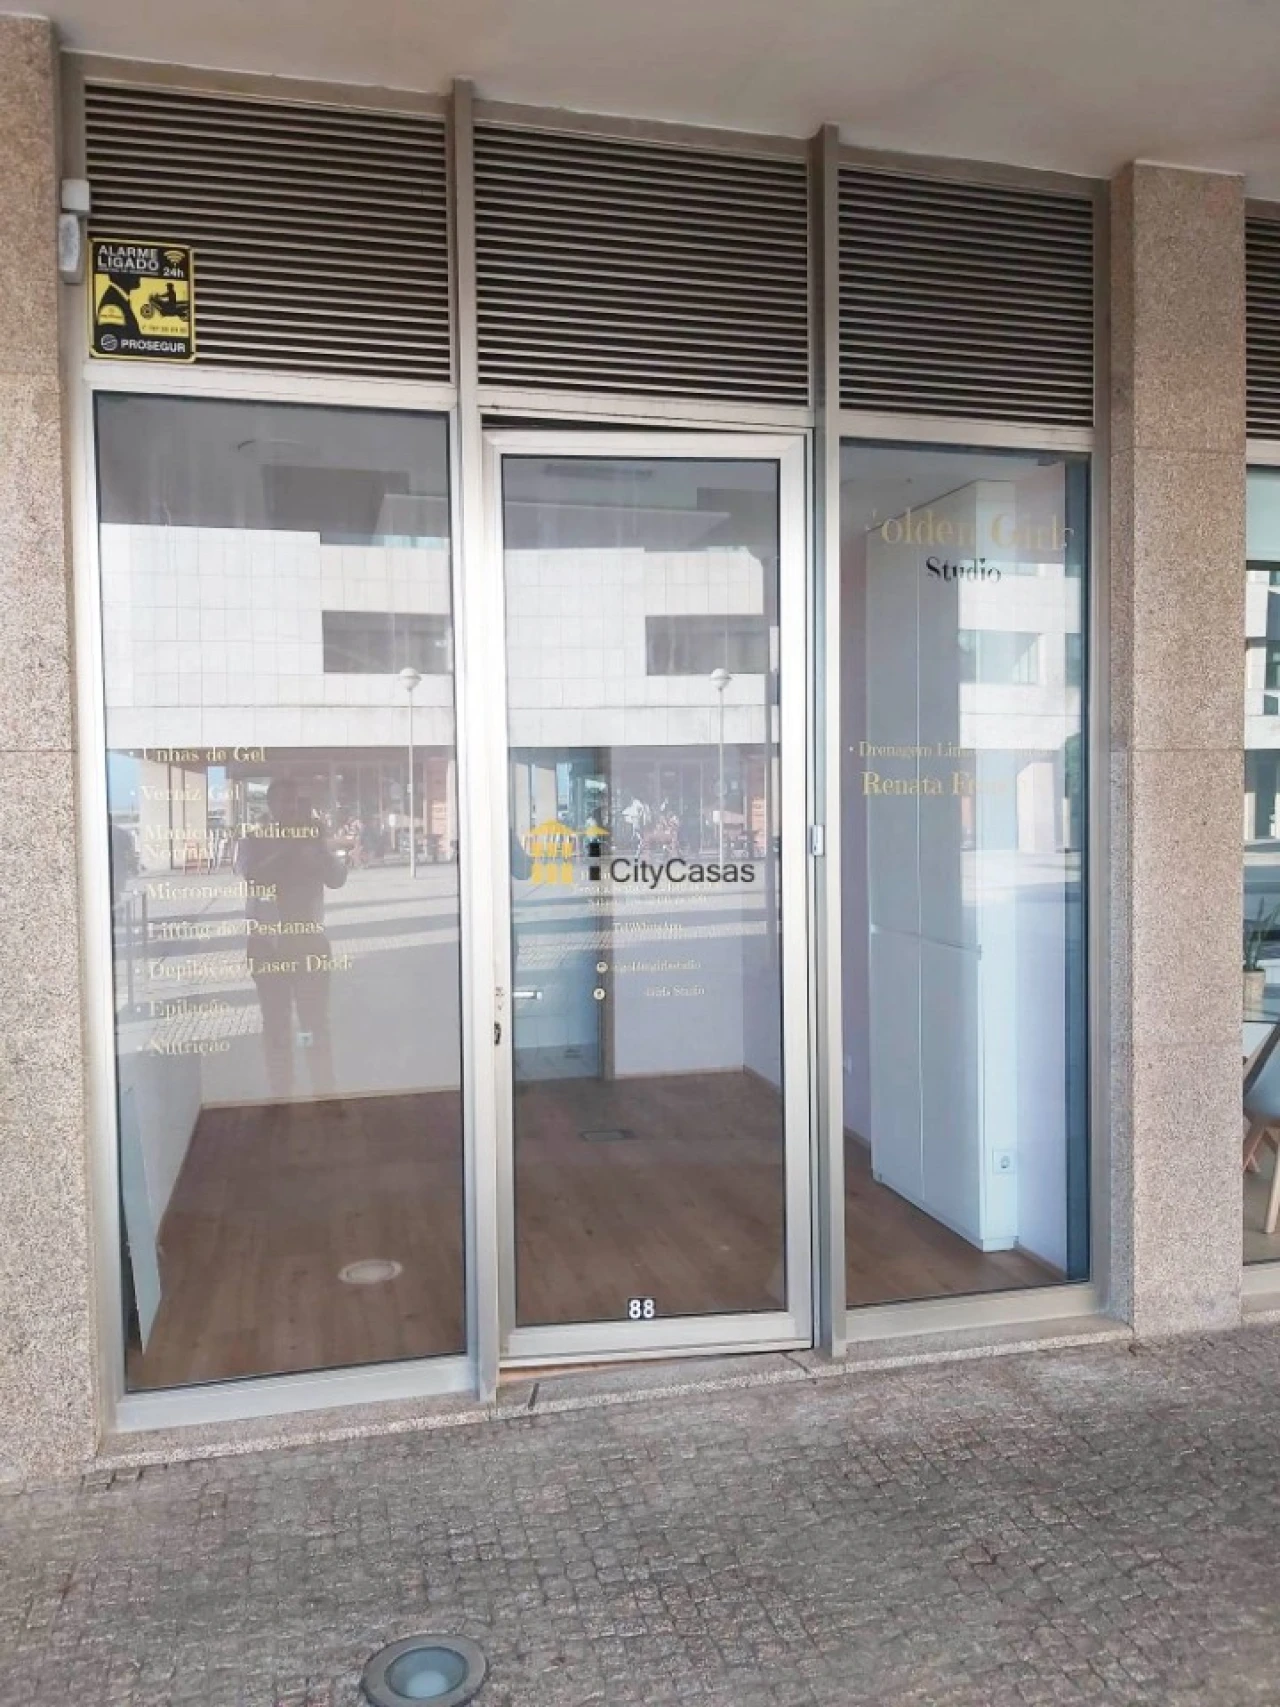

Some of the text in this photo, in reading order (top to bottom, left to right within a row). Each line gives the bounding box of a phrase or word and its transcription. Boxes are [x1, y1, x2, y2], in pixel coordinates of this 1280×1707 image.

[98, 244, 159, 259] ALARME
[97, 255, 159, 272] LIGADO
[162, 266, 184, 278] 24h
[120, 338, 186, 353] PROSEGUR
[925, 556, 1001, 584] Studio
[206, 746, 227, 762] de
[232, 746, 266, 762] Gel
[861, 770, 942, 796] Renata
[245, 919, 325, 937] Pestanas
[247, 956, 300, 975] Laser
[628, 1299, 655, 1319] 88
